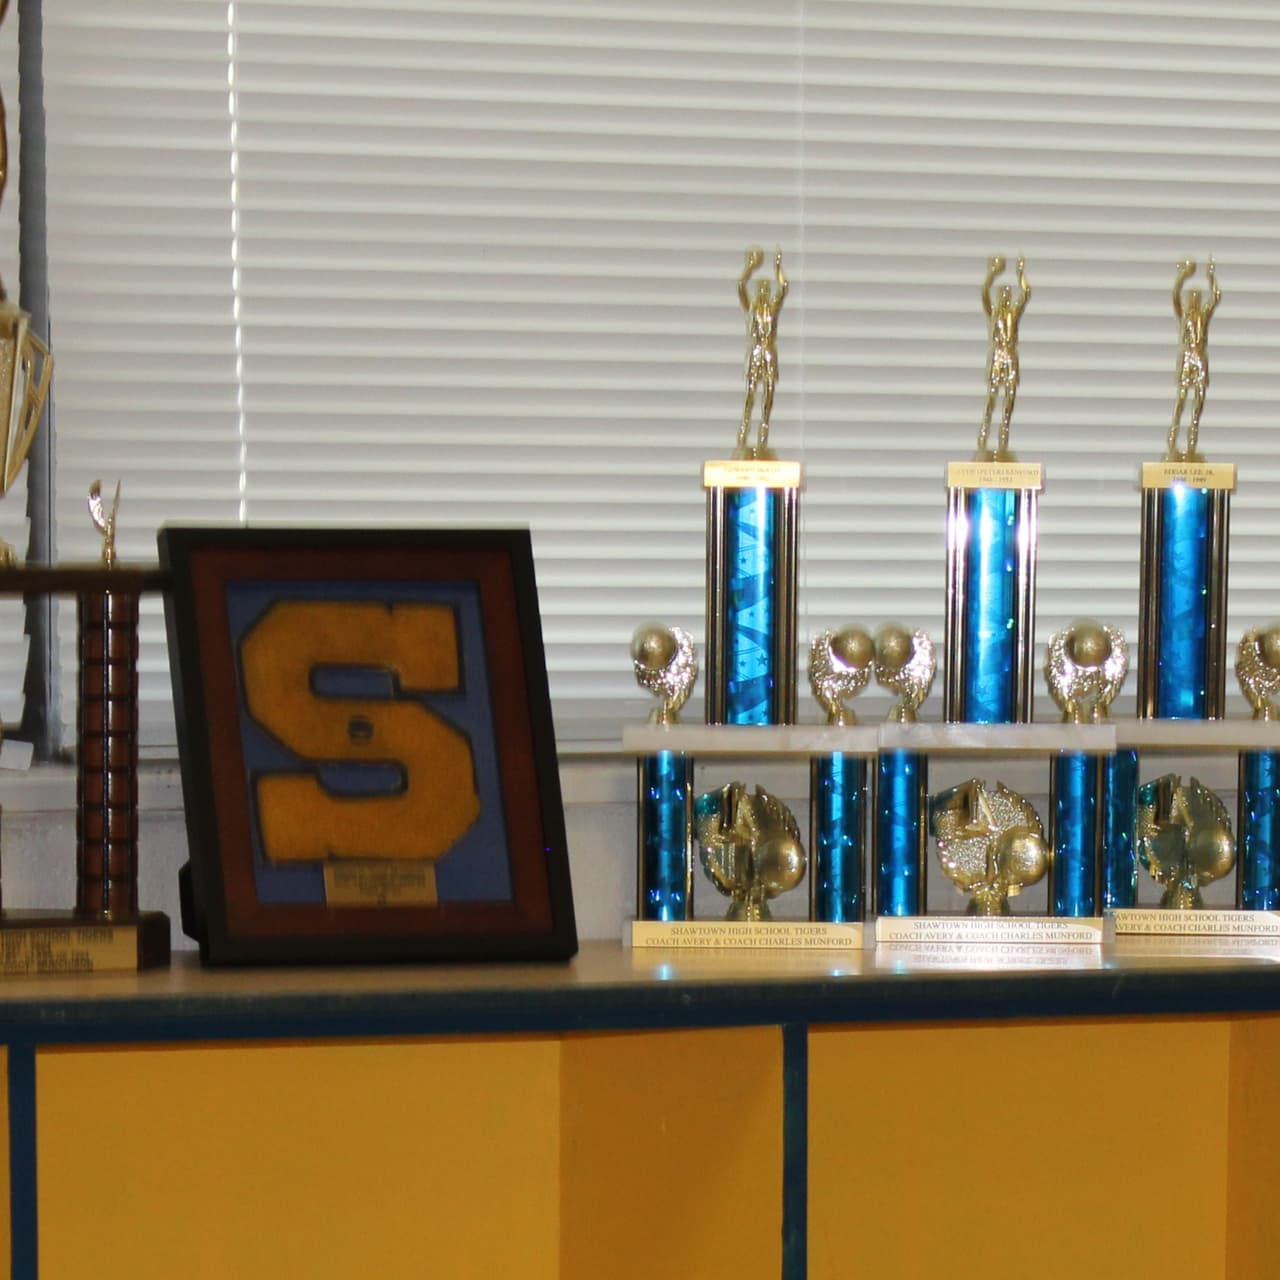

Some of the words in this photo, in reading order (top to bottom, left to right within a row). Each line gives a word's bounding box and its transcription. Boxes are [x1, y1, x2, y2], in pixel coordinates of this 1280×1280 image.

[236, 598, 481, 864] S
[1115, 912, 1156, 922] AWTOWN
[1158, 912, 1182, 922] HIGH
[1183, 912, 1220, 922] SCHOOL
[1222, 912, 1255, 922] TIGERS
[913, 920, 968, 929] SHAWTOWN
[996, 920, 1033, 929] SCHOOL
[1035, 920, 1069, 929] TIGERS
[1153, 923, 1186, 933] COACH
[1188, 923, 1230, 933] CHARLES
[1232, 923, 1279, 933] MUNFORD
[671, 927, 727, 936] SHAWTOWN
[728, 927, 752, 936] HIGH
[754, 927, 790, 936] SCHOOL
[794, 927, 827, 936] TIGERS
[889, 931, 922, 941] COACH
[924, 931, 953, 941] AVERY
[1000, 931, 1043, 941] CHARLES
[1045, 931, 1093, 941] MUNFORD
[645, 937, 679, 946] COACH
[681, 937, 712, 946] AVERY
[723, 937, 757, 946] COACH
[759, 937, 802, 946] CHARLES
[804, 937, 852, 946] MUNFORD
